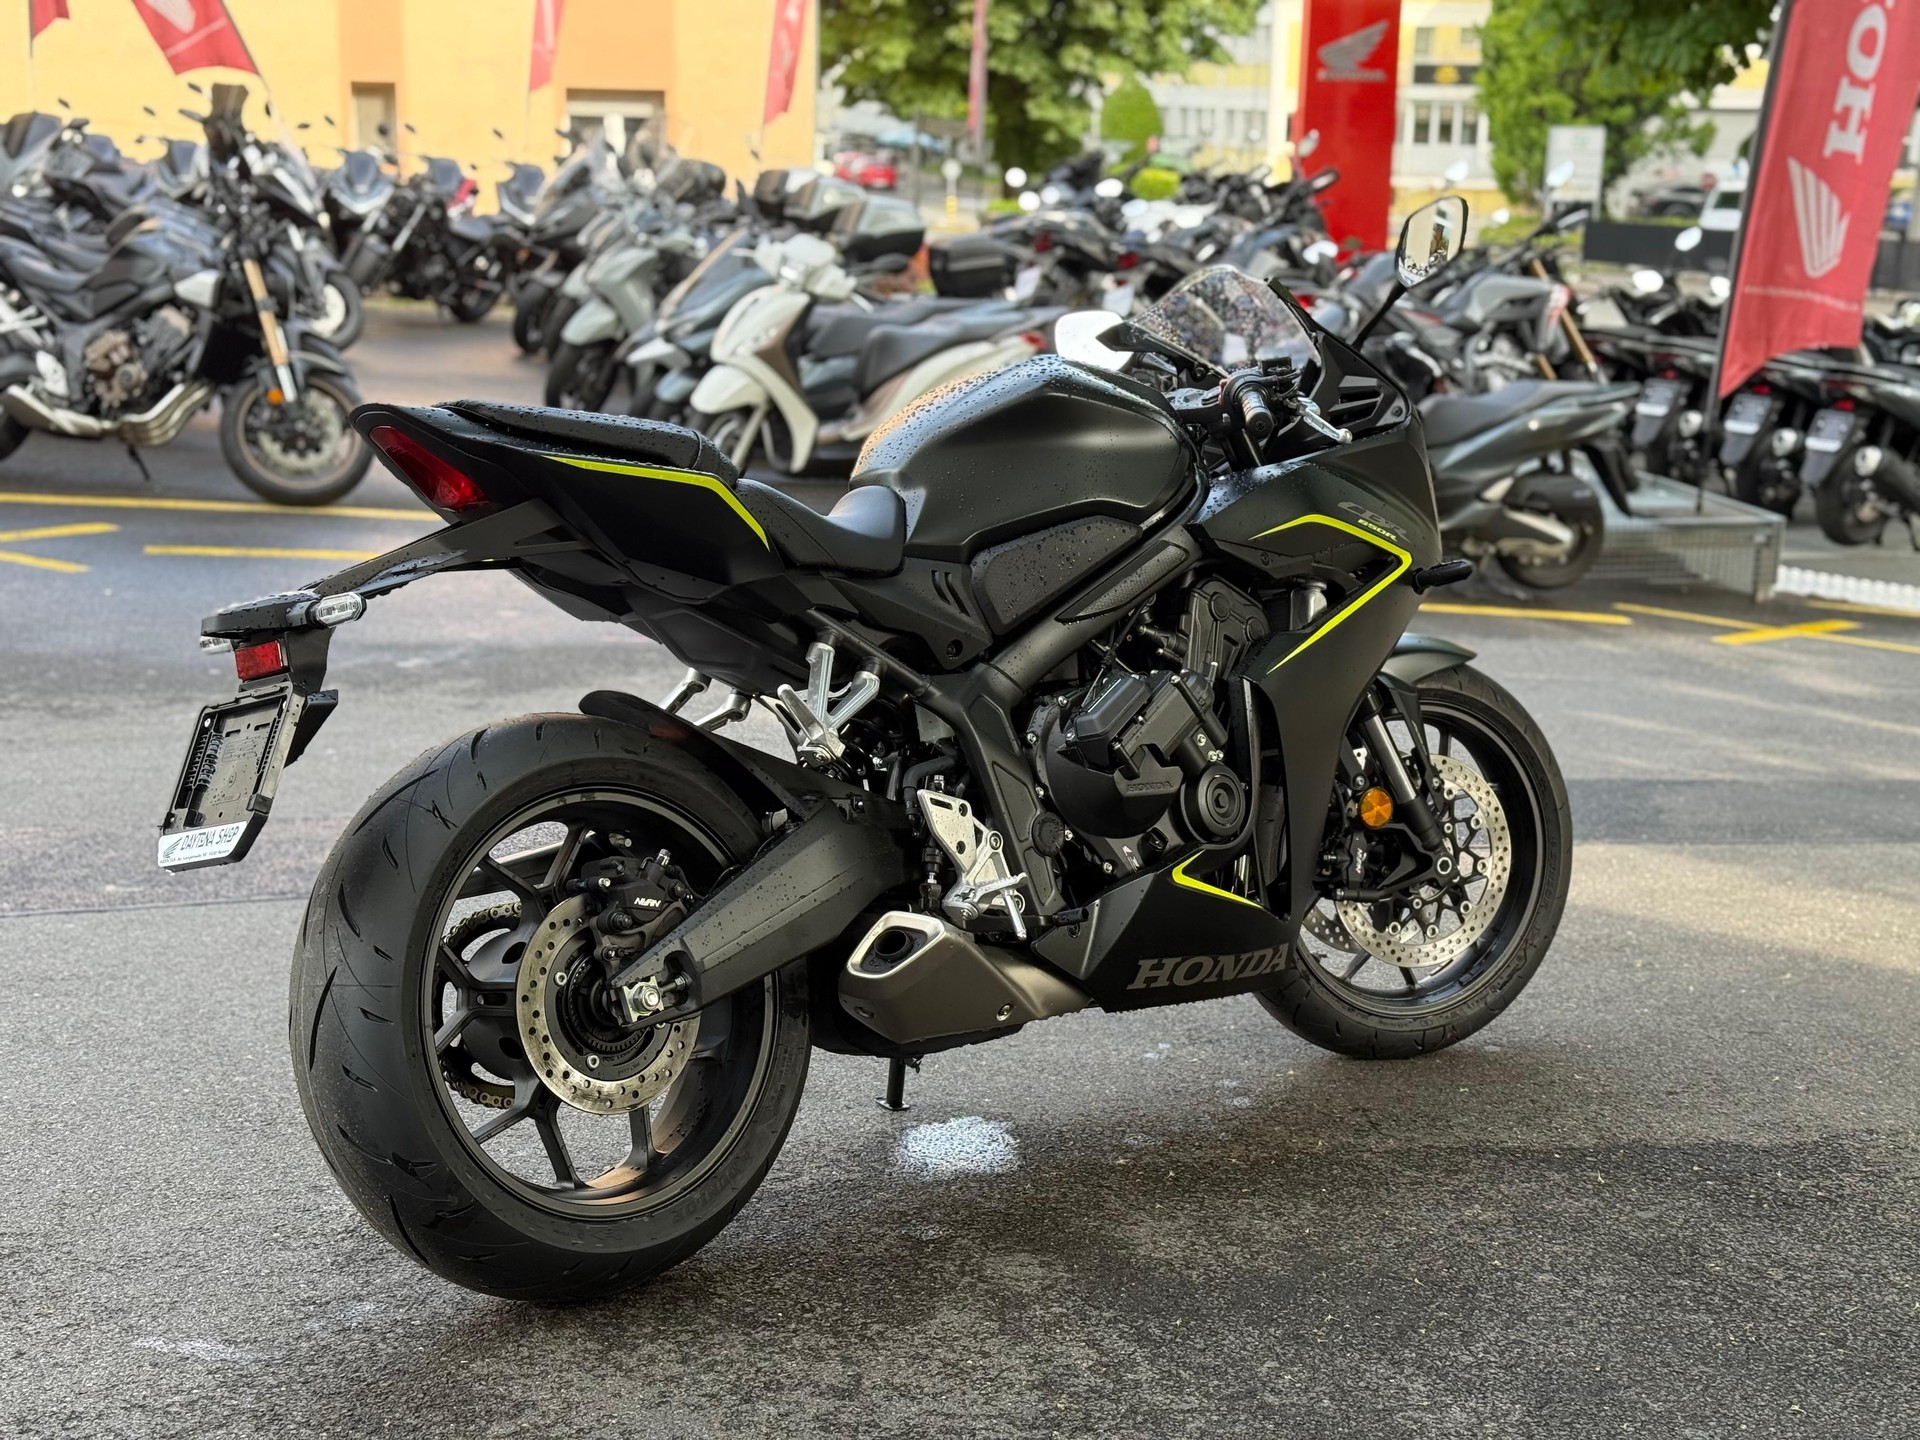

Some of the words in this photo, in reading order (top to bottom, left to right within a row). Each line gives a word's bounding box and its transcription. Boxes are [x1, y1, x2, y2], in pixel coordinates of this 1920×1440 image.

[1822, 0, 1896, 164] HO
[1358, 519, 1398, 542] 650R
[180, 830, 217, 851] DAYTONA
[215, 826, 240, 845] SHOP
[1126, 942, 1290, 990] HONDA
